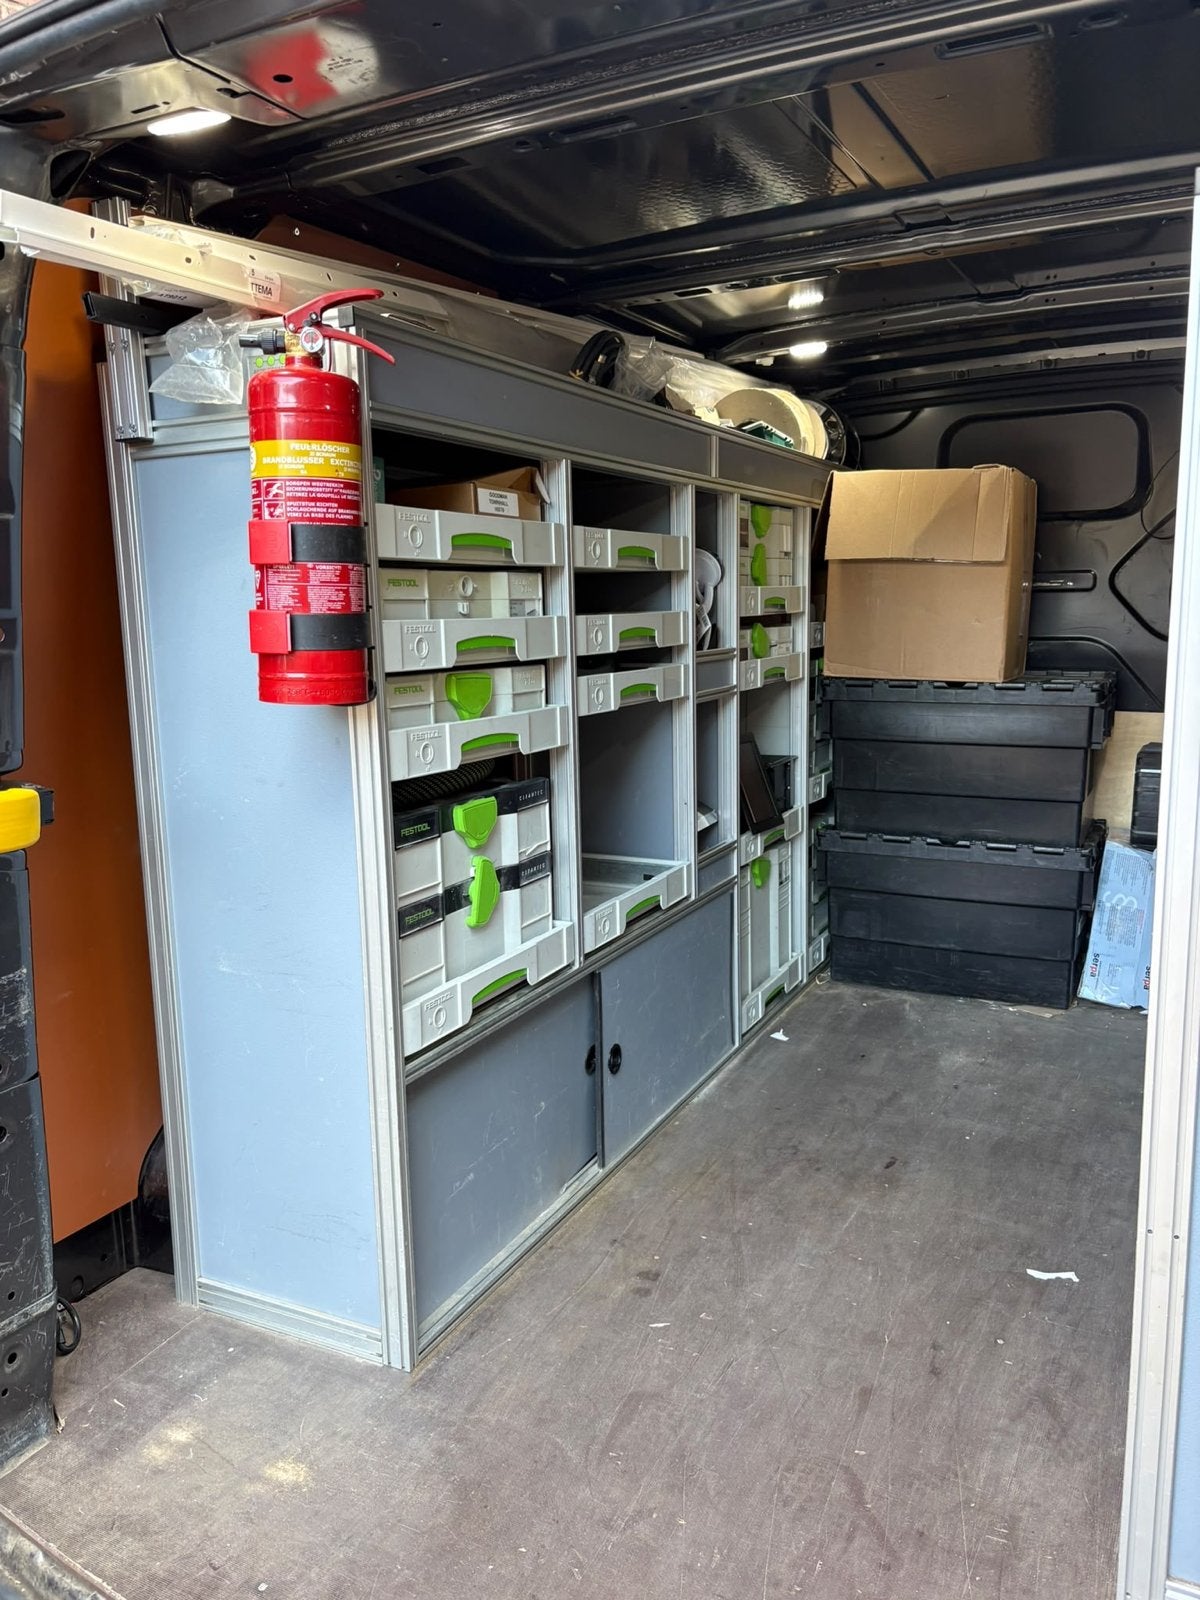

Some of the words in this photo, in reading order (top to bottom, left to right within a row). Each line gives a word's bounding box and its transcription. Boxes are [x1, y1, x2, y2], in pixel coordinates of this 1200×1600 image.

[290, 443, 350, 453] FEUERLÖSCHER
[262, 456, 325, 464] BRANDBLUSSER
[398, 512, 432, 524] FESTOOL
[387, 578, 419, 588] FESTOOL
[405, 624, 437, 634] FESTOOL
[394, 685, 425, 695] FESTOOL
[410, 728, 442, 742] FESTOOL
[518, 789, 544, 801] CLEANTEC
[400, 823, 431, 838] FESTOOL
[521, 863, 547, 877] CLEANTEC
[404, 908, 435, 926] FESTOOL
[1090, 953, 1100, 977] serpa
[1143, 965, 1151, 990] serpa
[424, 991, 455, 1010] FESTOOL
